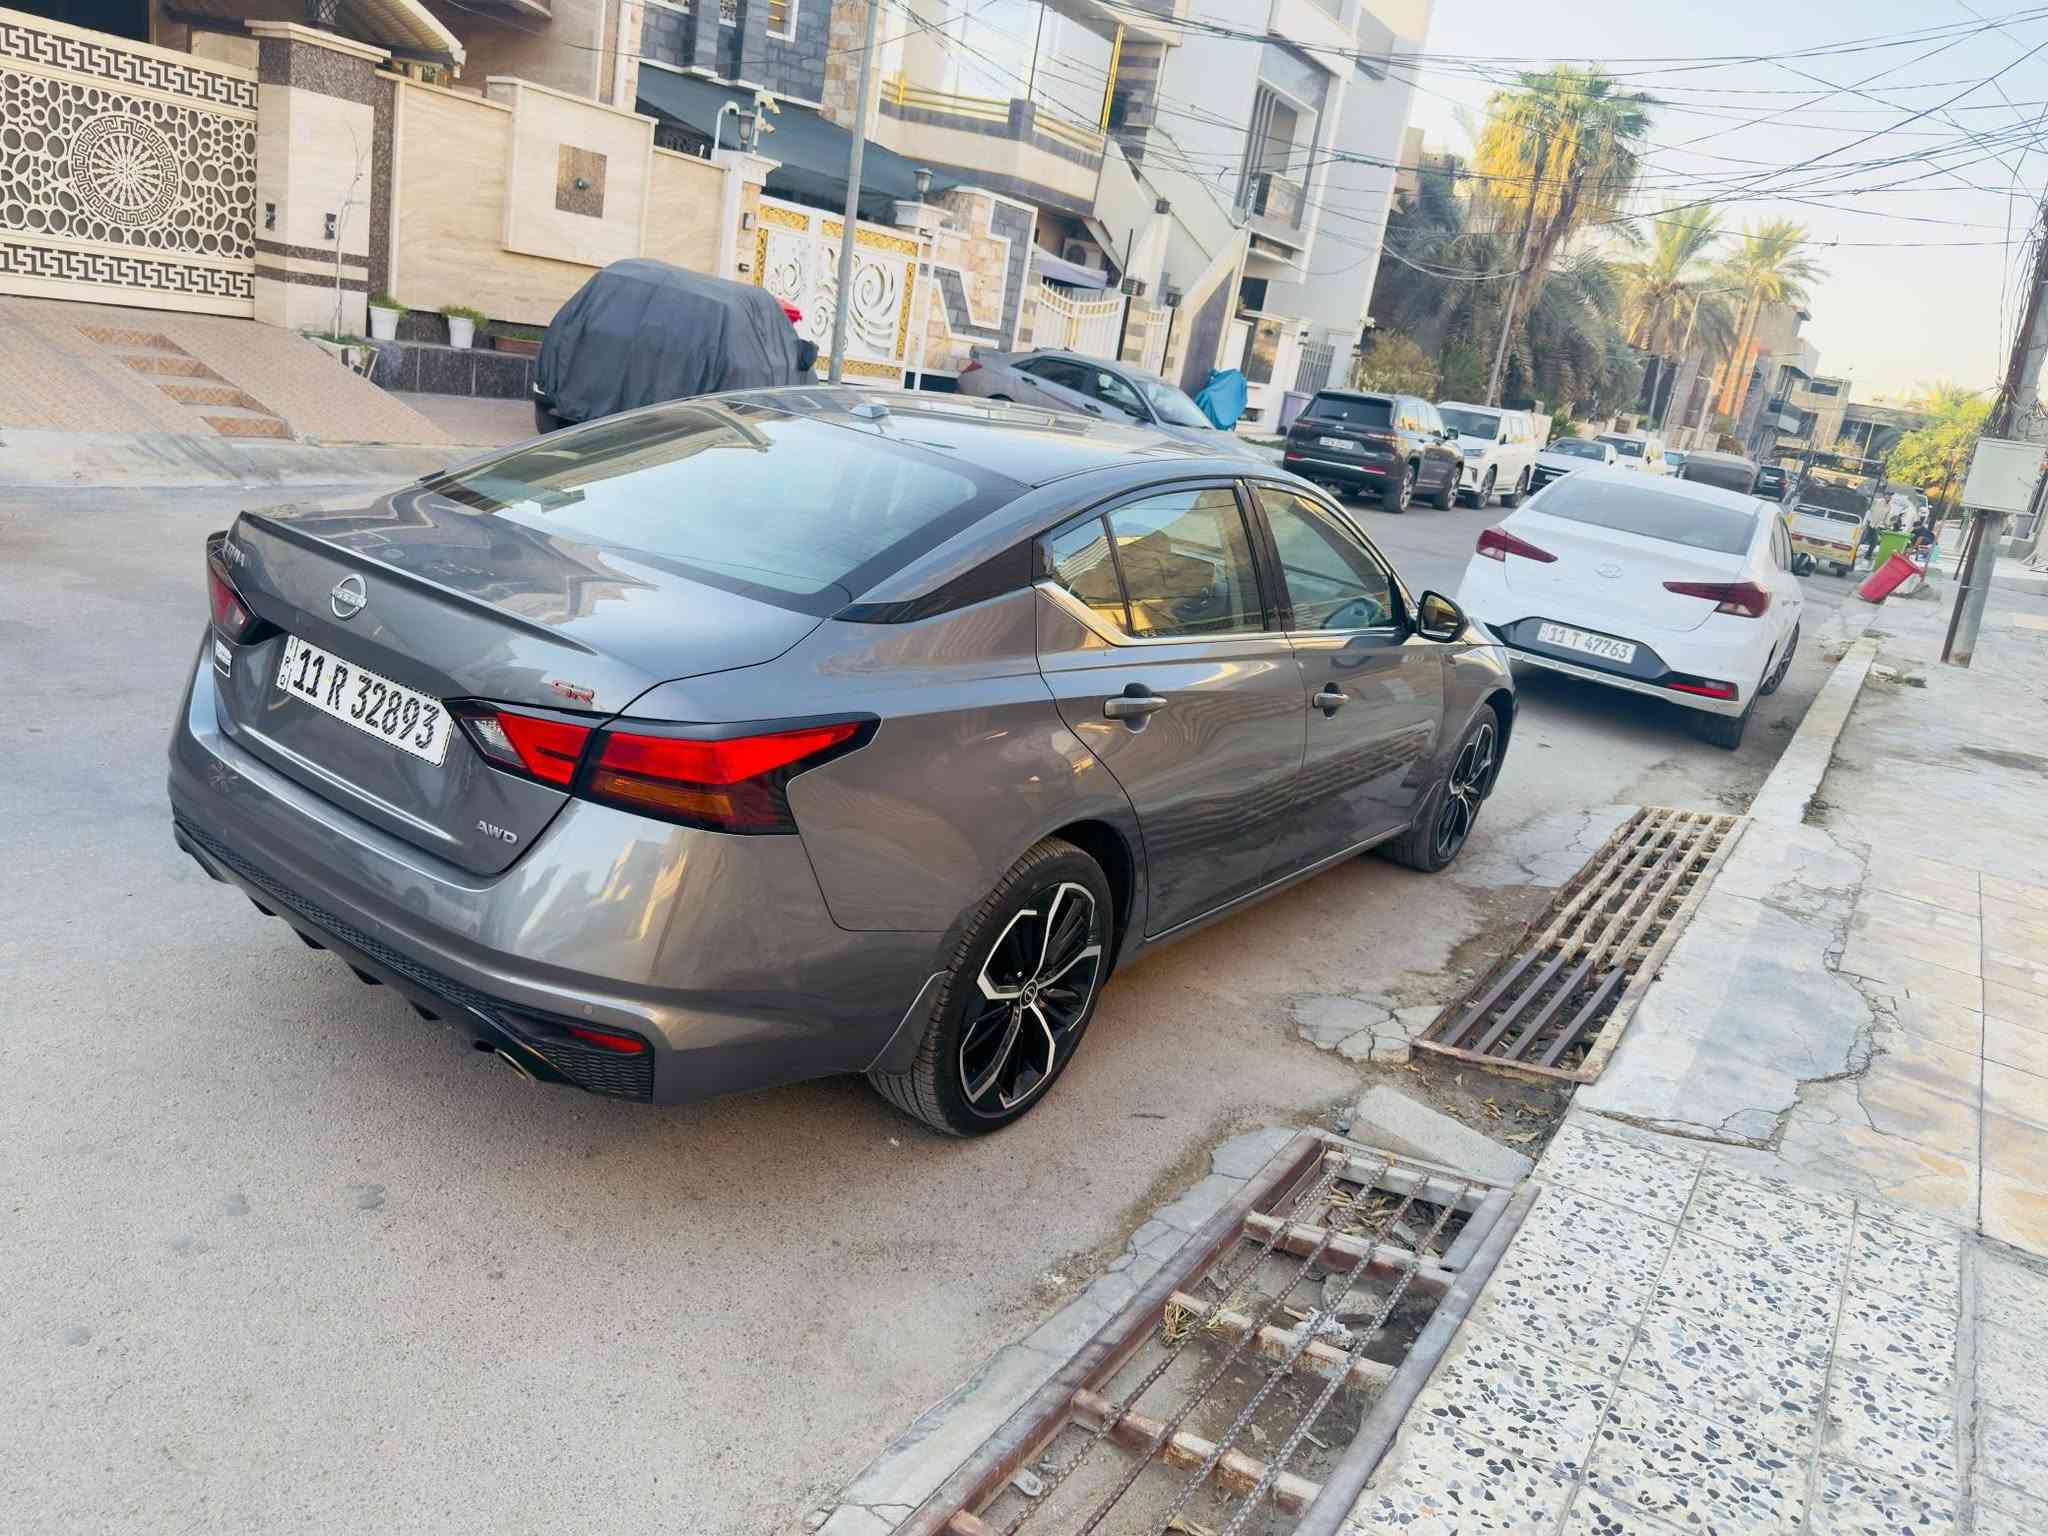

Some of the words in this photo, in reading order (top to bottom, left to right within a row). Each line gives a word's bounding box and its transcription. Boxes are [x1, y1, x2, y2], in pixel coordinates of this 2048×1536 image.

[1547, 626, 1567, 643] 11
[1572, 631, 1582, 647] T
[293, 648, 325, 698] 11
[326, 663, 348, 710] R
[351, 674, 440, 749] 32893
[476, 820, 518, 844] AWD
